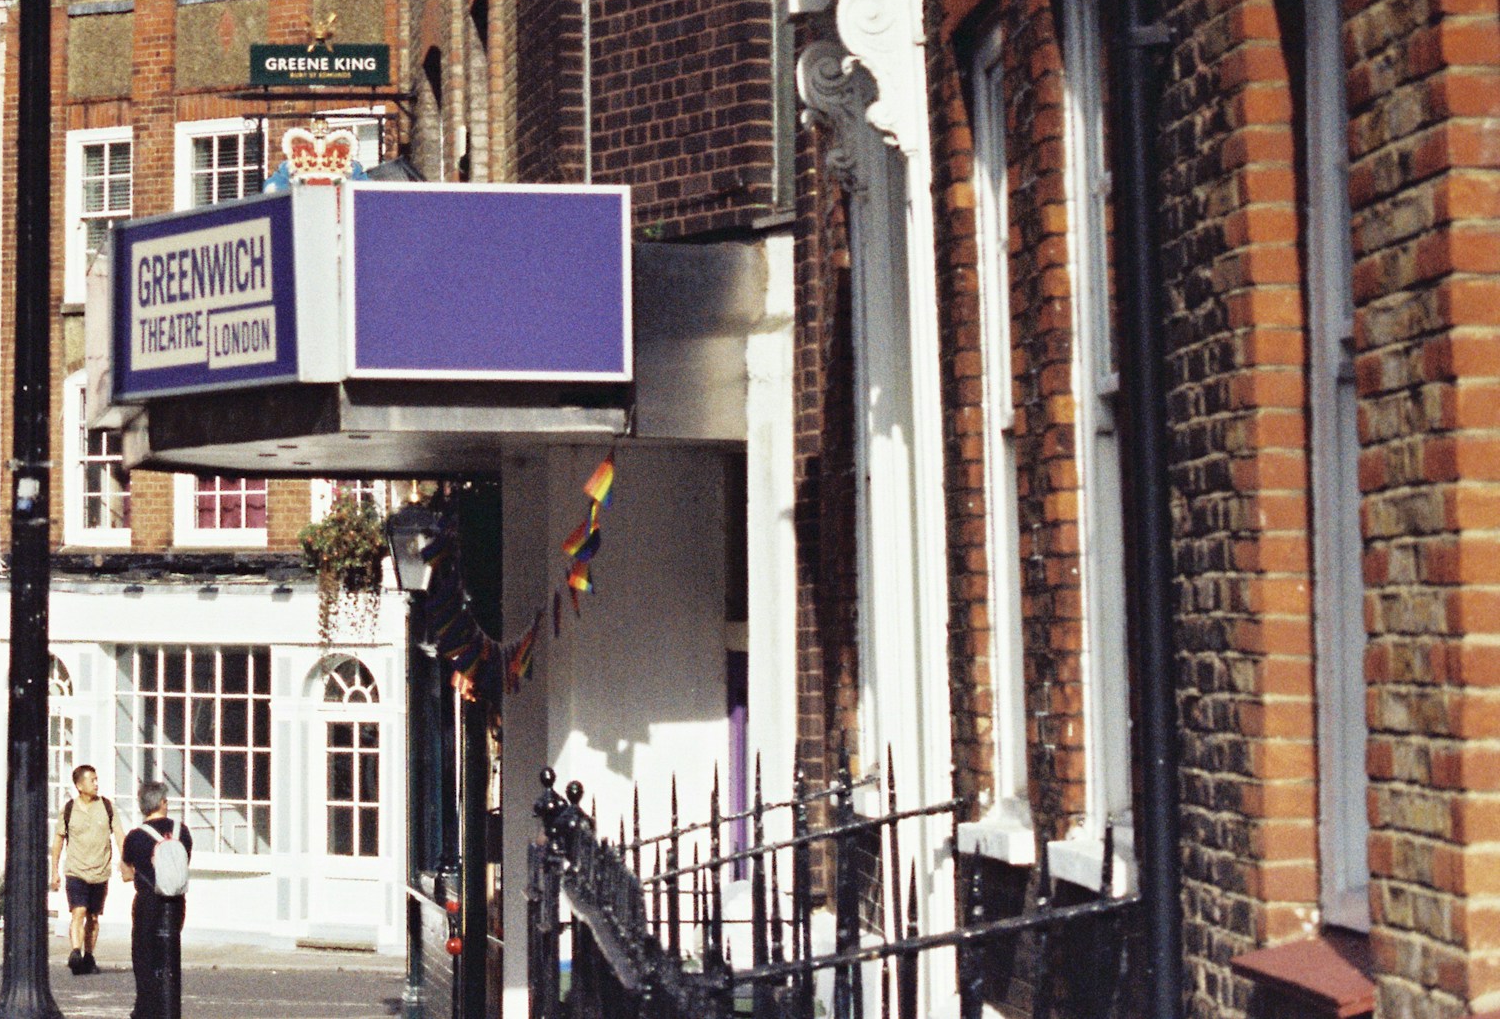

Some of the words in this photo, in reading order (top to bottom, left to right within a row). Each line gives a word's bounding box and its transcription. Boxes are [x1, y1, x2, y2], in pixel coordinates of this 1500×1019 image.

[265, 57, 329, 72] GREENE
[334, 57, 377, 72] KING
[137, 235, 266, 309] GREENWICH
[139, 310, 203, 354] THEATRE
[214, 318, 271, 357] LONDON
